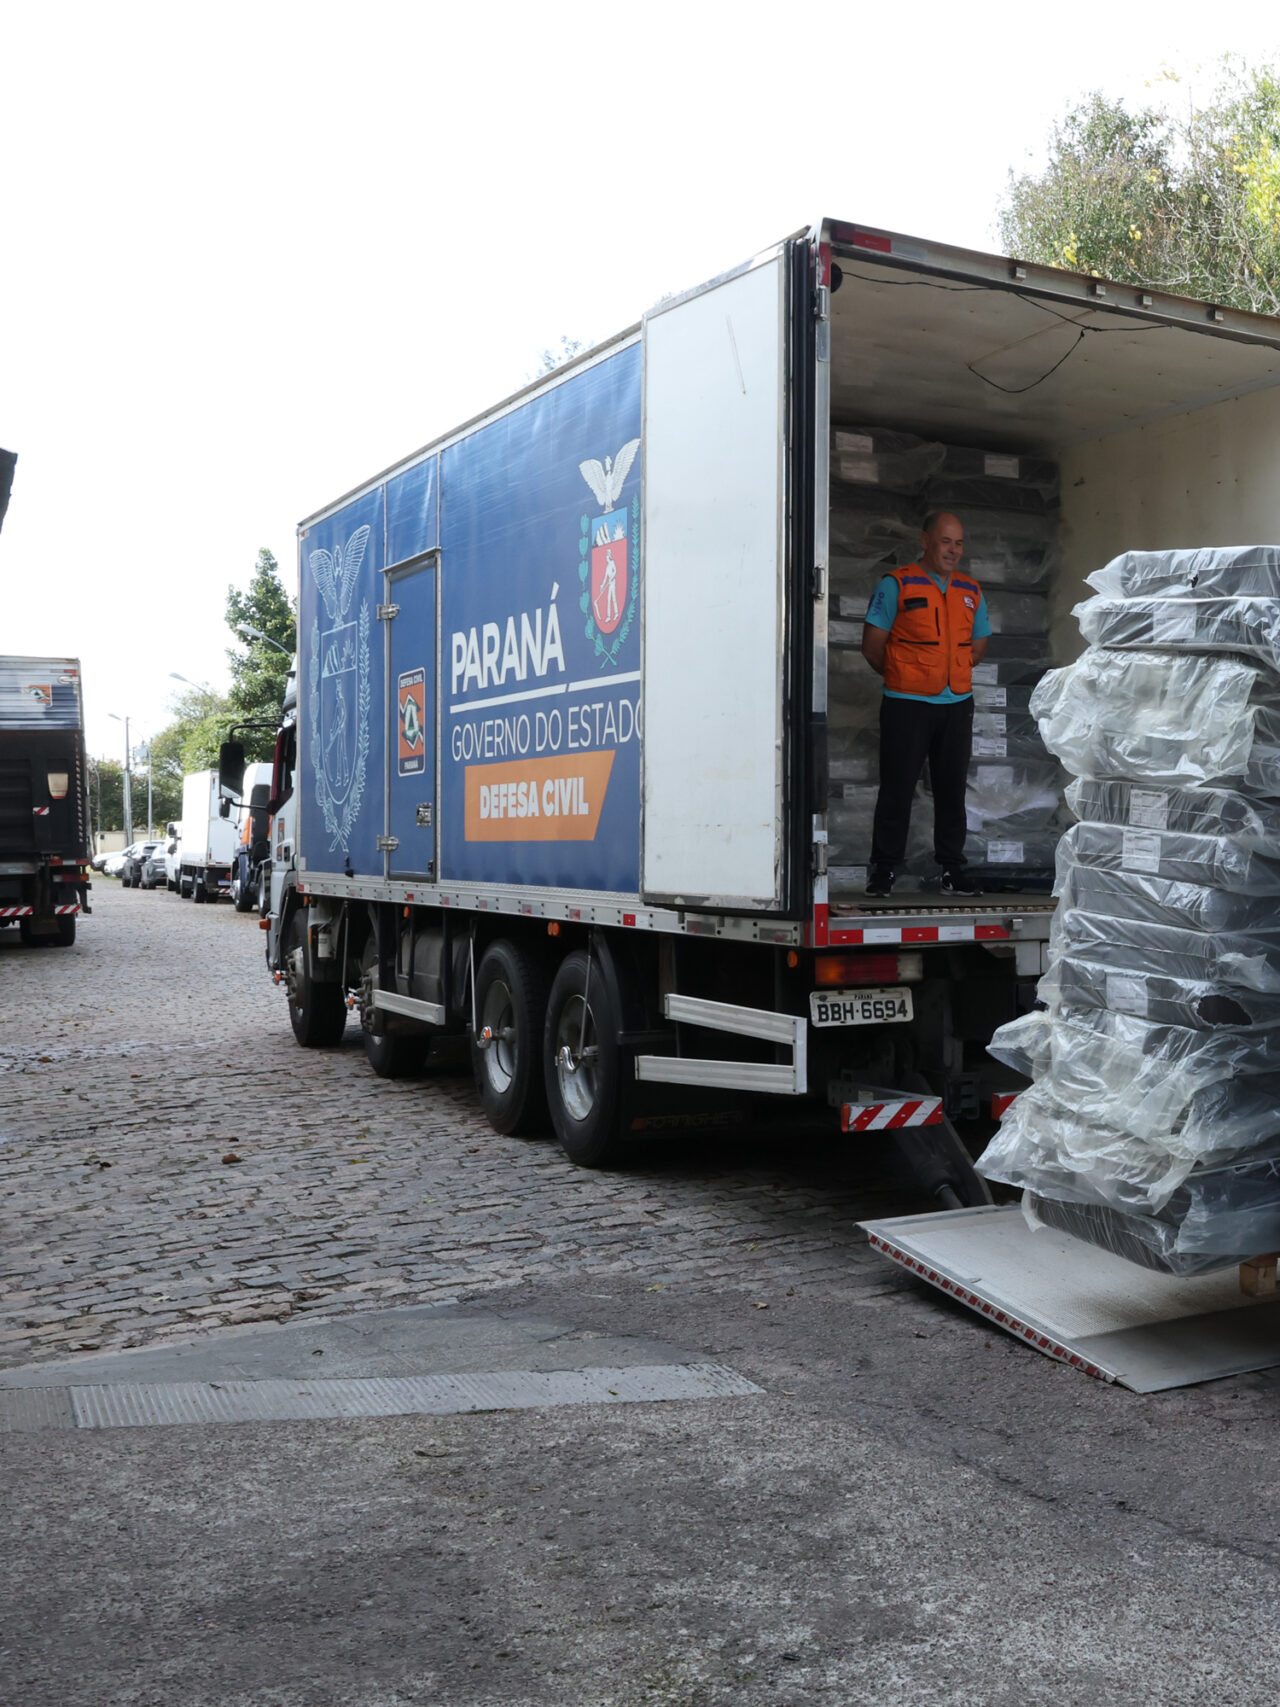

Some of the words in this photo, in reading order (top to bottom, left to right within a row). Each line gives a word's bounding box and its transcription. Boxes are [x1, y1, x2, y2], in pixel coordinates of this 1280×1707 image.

[451, 581, 566, 695] PARANÁ
[451, 713, 531, 762] GOVERNO
[535, 708, 562, 752] DO
[479, 780, 540, 820] DEFESA
[542, 776, 589, 817] CIVIL
